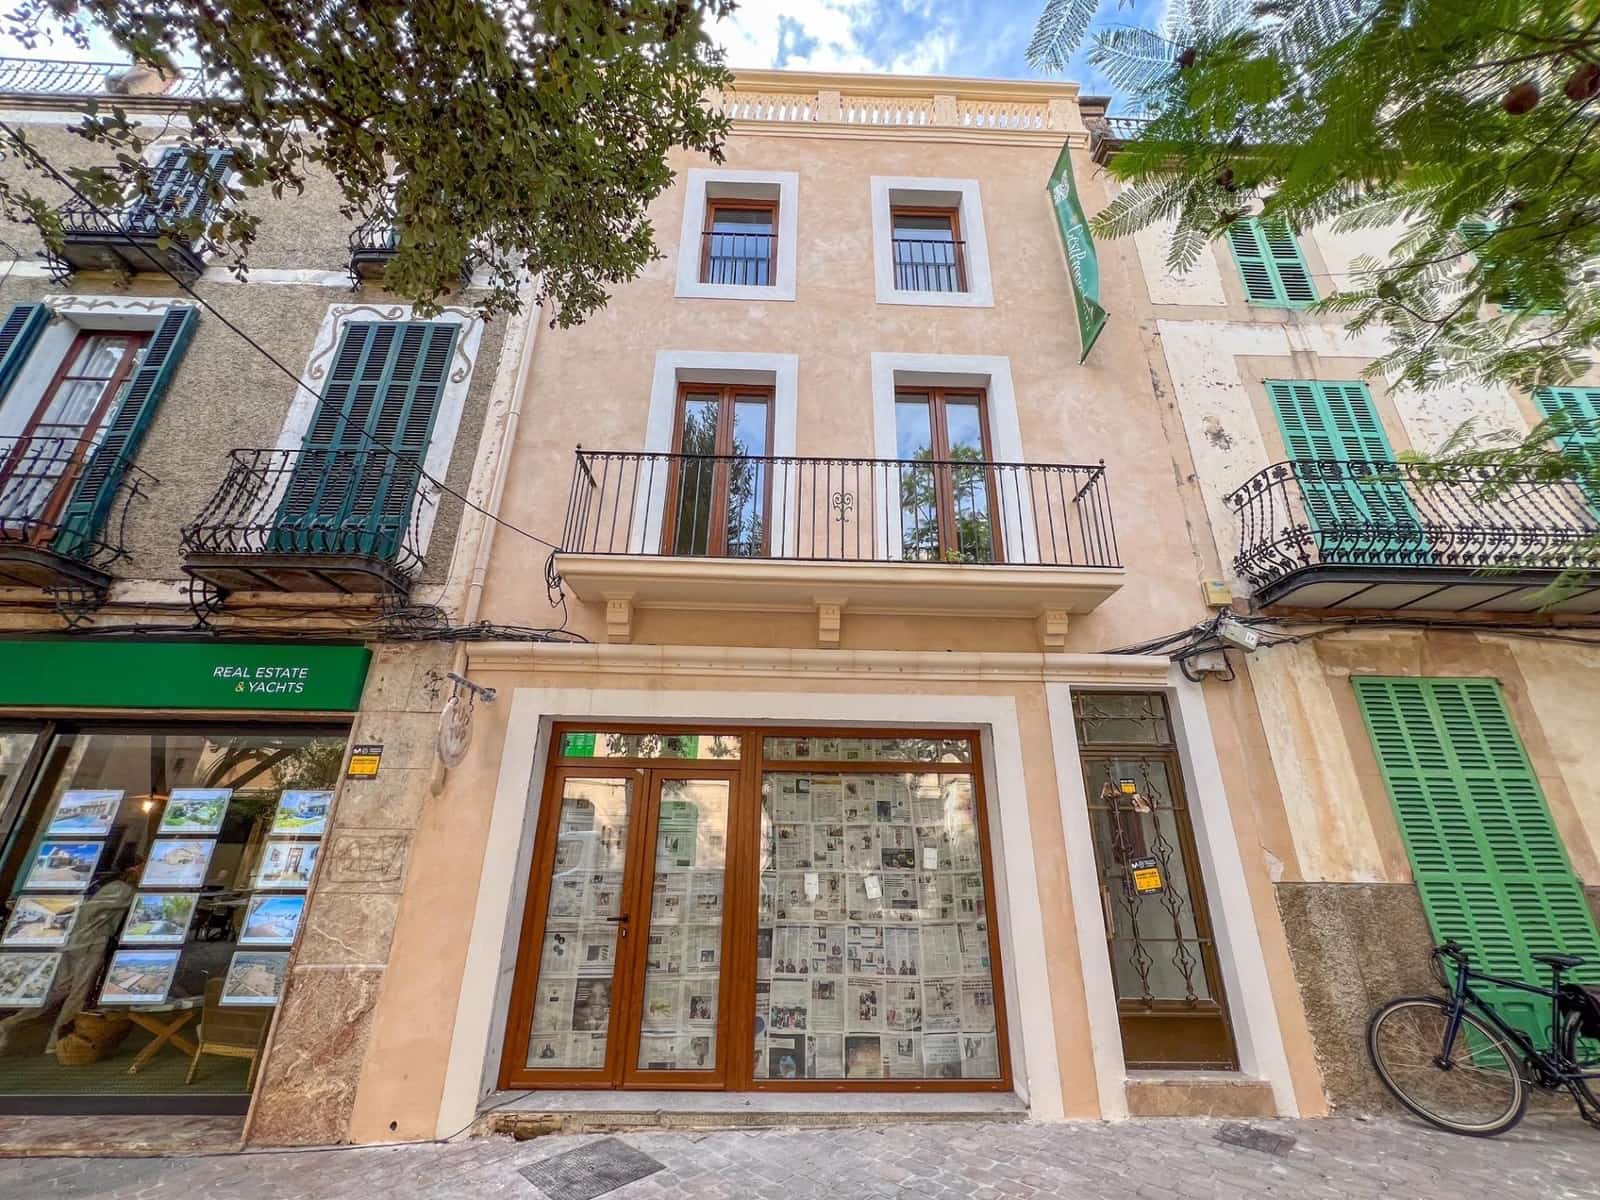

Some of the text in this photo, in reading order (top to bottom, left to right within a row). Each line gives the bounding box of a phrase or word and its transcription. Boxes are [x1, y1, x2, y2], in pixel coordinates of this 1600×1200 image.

[213, 666, 309, 679] REAL ESTATE
[235, 682, 305, 694] & YACHTS
